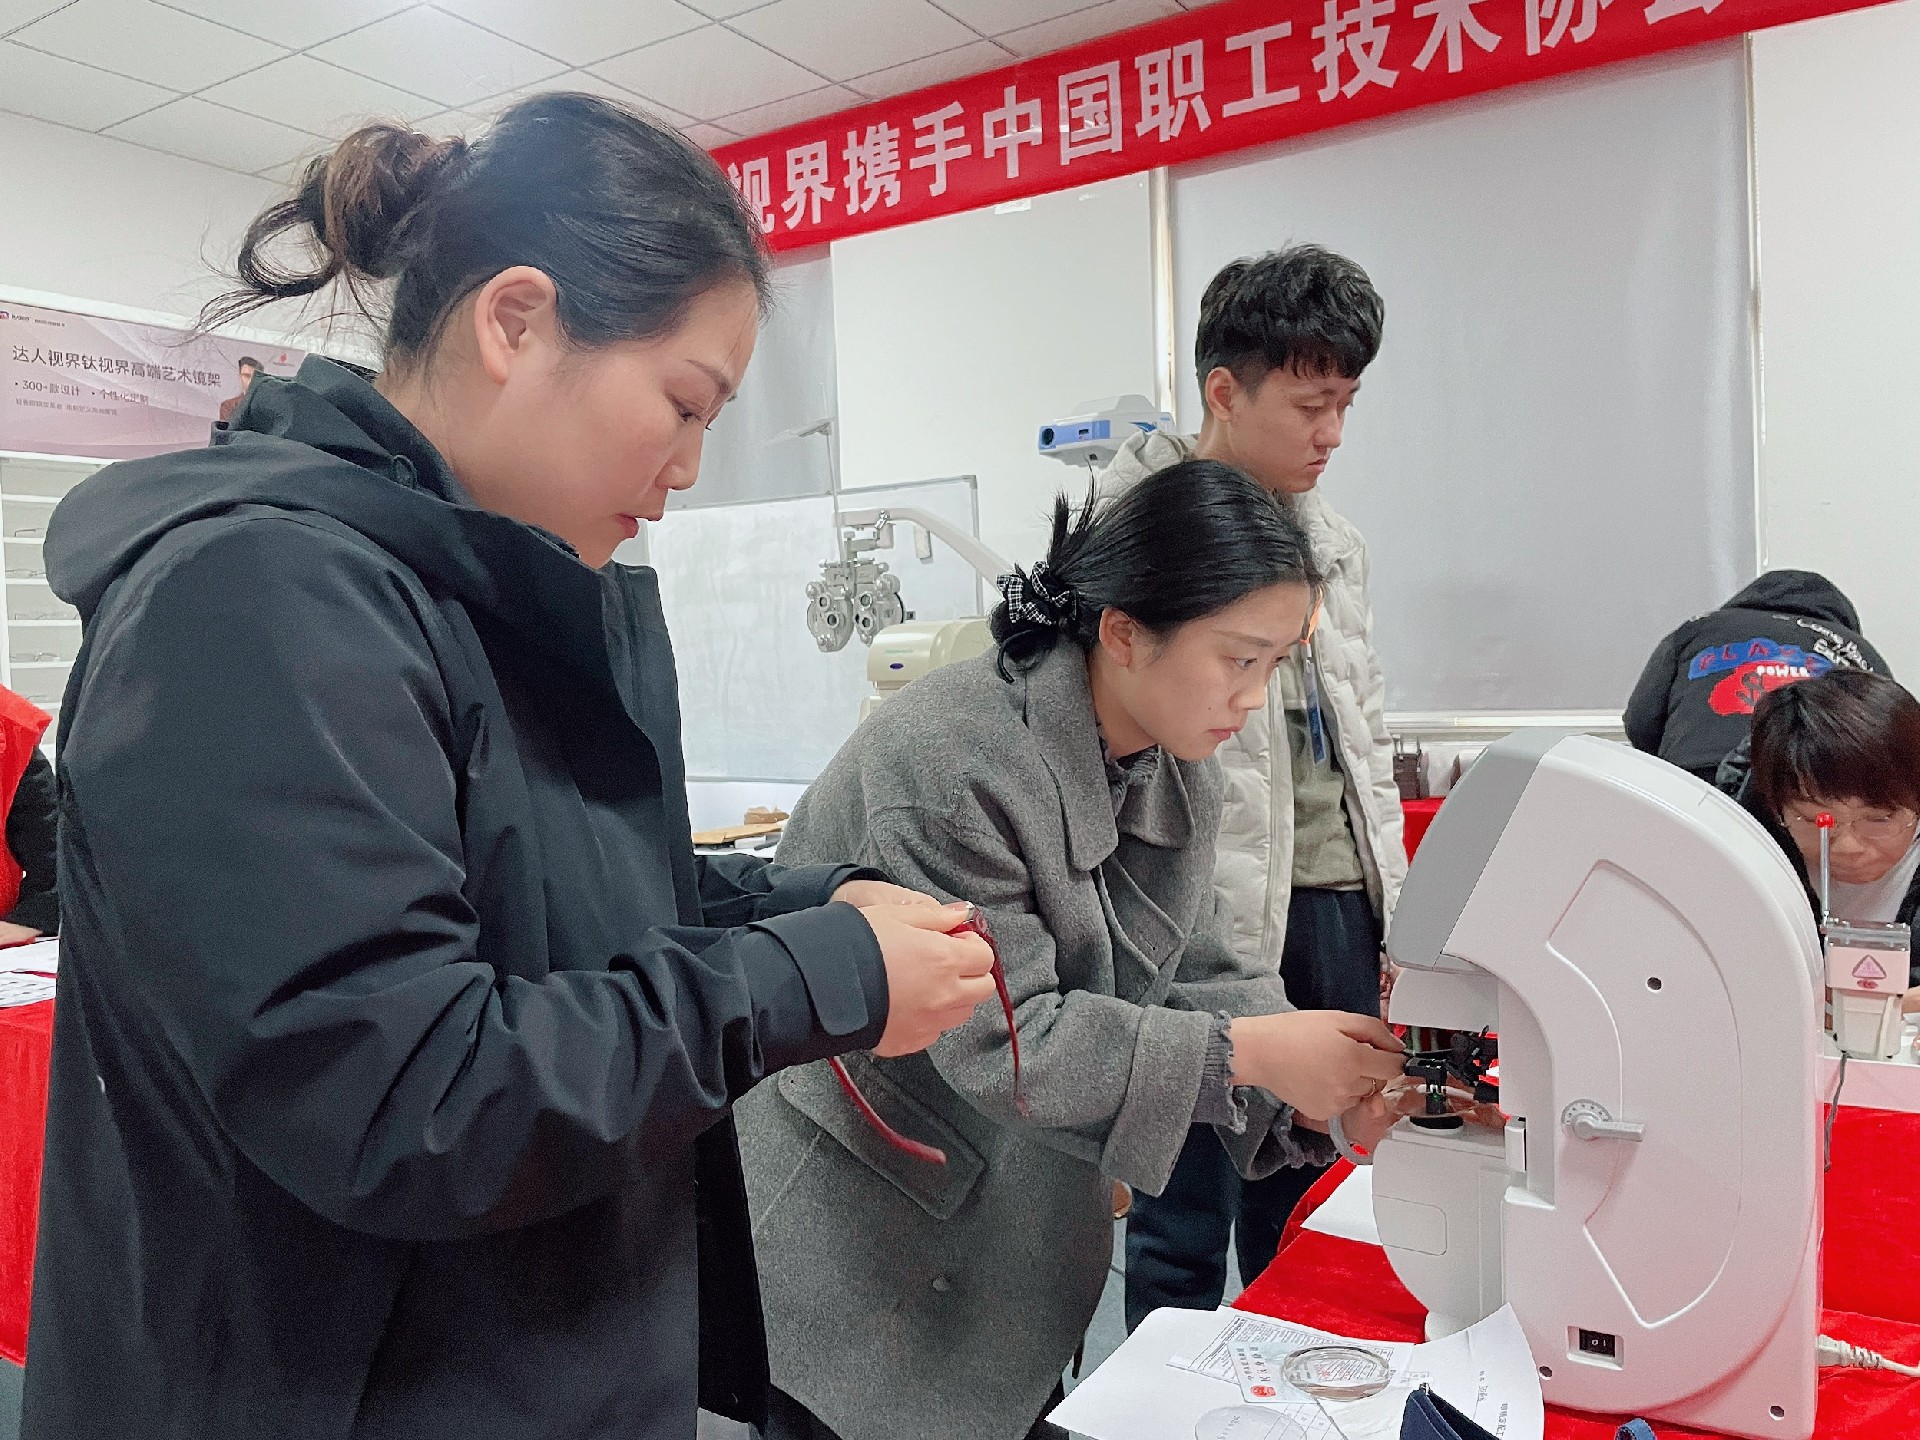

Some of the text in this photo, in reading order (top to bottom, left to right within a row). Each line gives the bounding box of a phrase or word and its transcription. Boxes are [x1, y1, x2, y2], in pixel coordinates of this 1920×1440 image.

[12, 345, 222, 388] 达人视界钛视界高端艺术镜架
